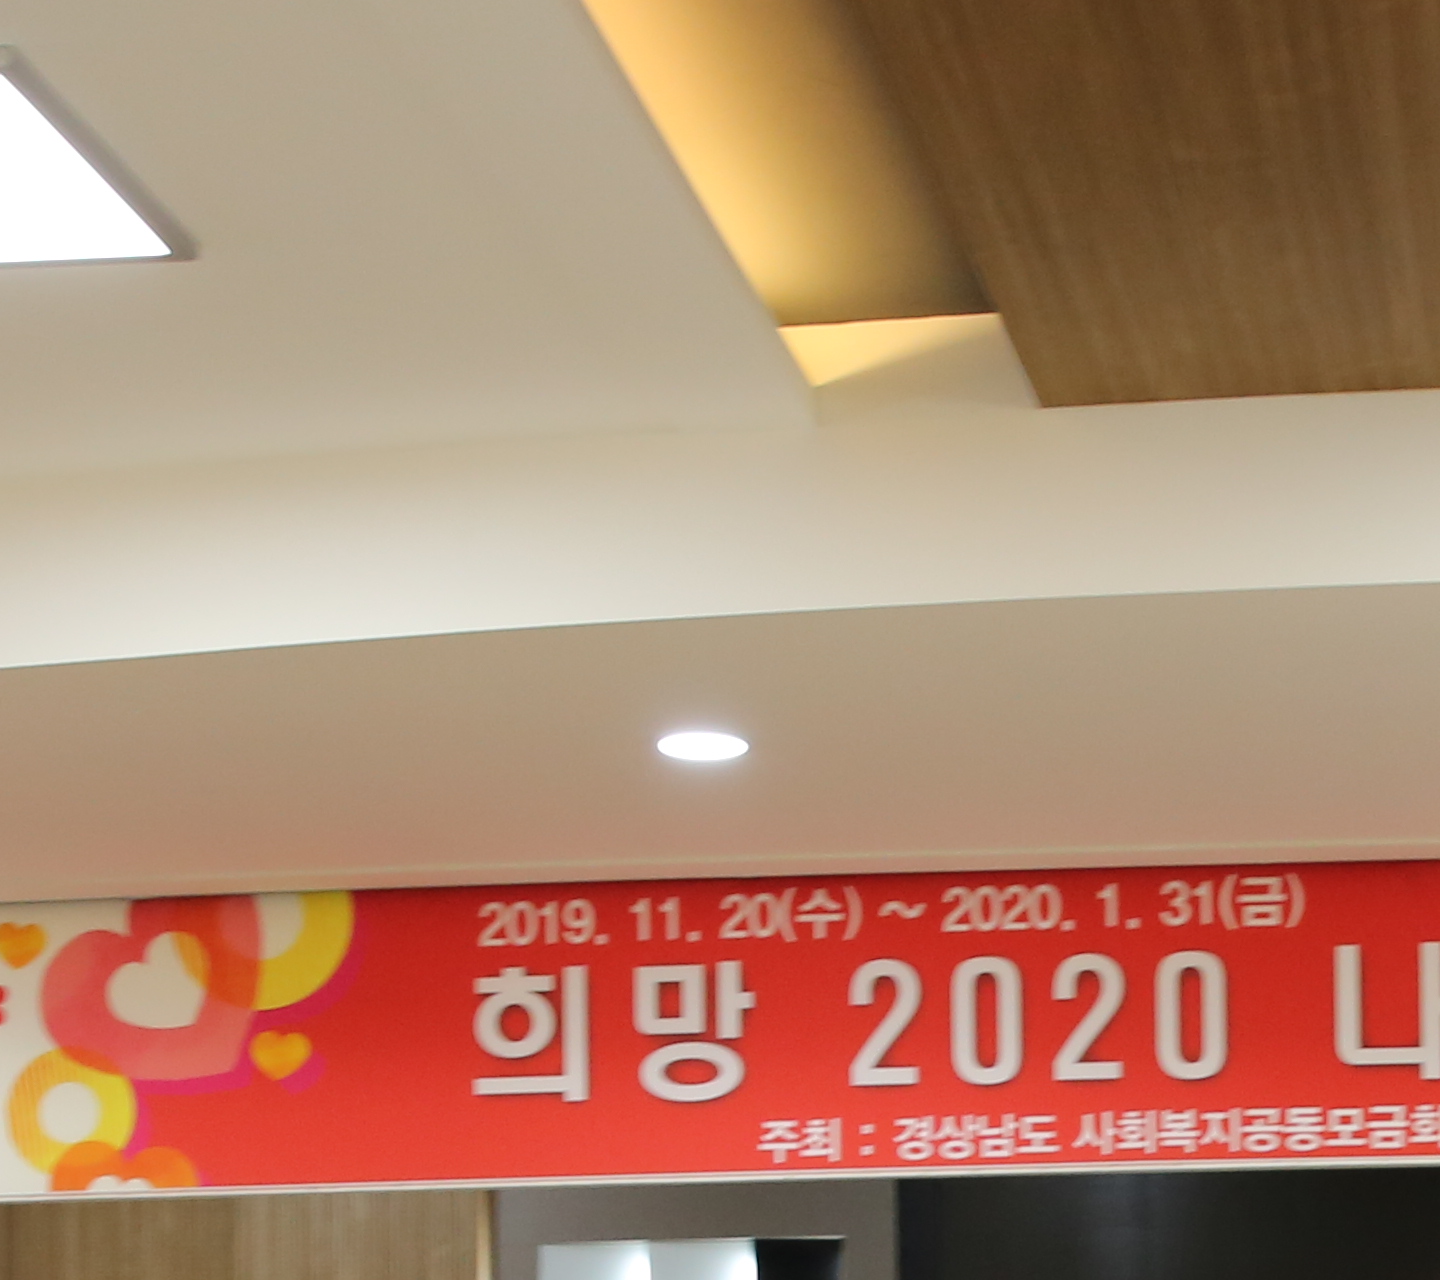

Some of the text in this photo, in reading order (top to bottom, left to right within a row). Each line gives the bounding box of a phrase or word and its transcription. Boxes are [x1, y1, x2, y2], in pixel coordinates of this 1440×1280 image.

[477, 899, 610, 947] 2019.
[628, 896, 703, 943] 11.
[940, 883, 1077, 932] 2020.
[471, 959, 756, 1103] 희망
[846, 948, 1229, 1087] 2020
[757, 1117, 843, 1163] 주최
[892, 1113, 1060, 1162] 경상남도
